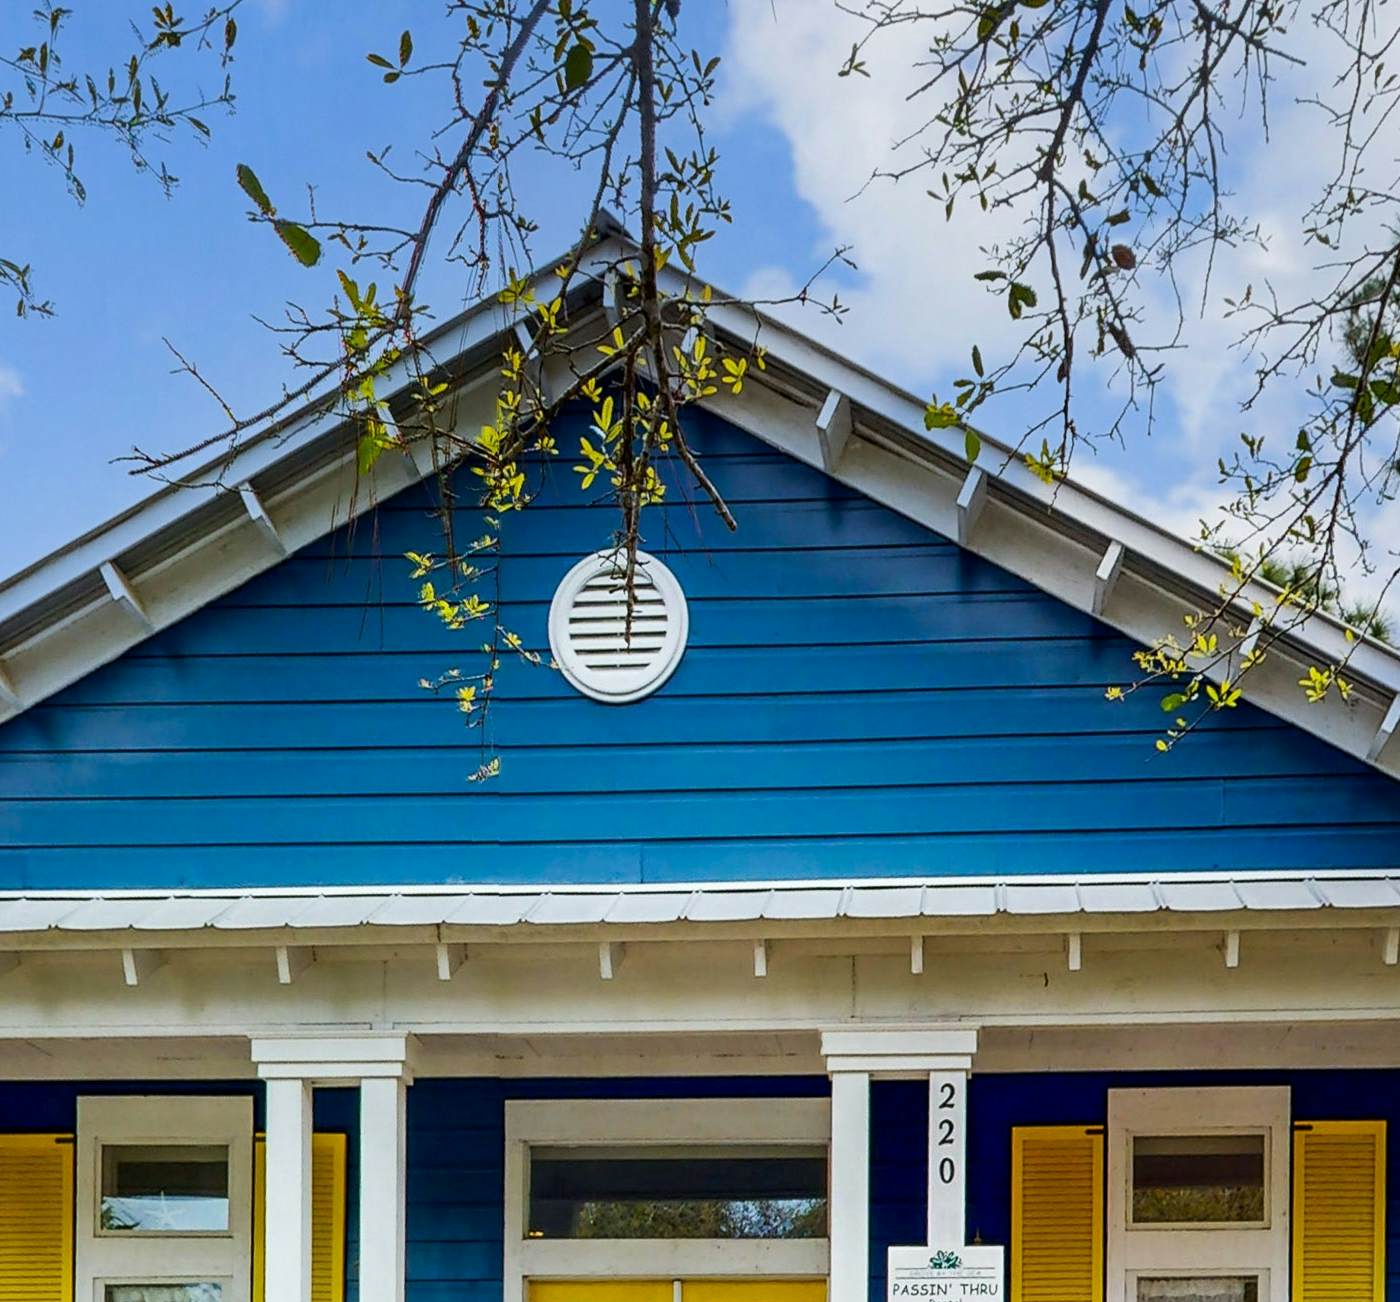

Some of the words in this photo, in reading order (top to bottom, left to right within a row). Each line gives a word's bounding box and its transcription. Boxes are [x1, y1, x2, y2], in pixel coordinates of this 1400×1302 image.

[938, 1083, 955, 1184] 220
[893, 1283, 952, 1296] PASSIN'
[960, 1283, 998, 1296] THRU
